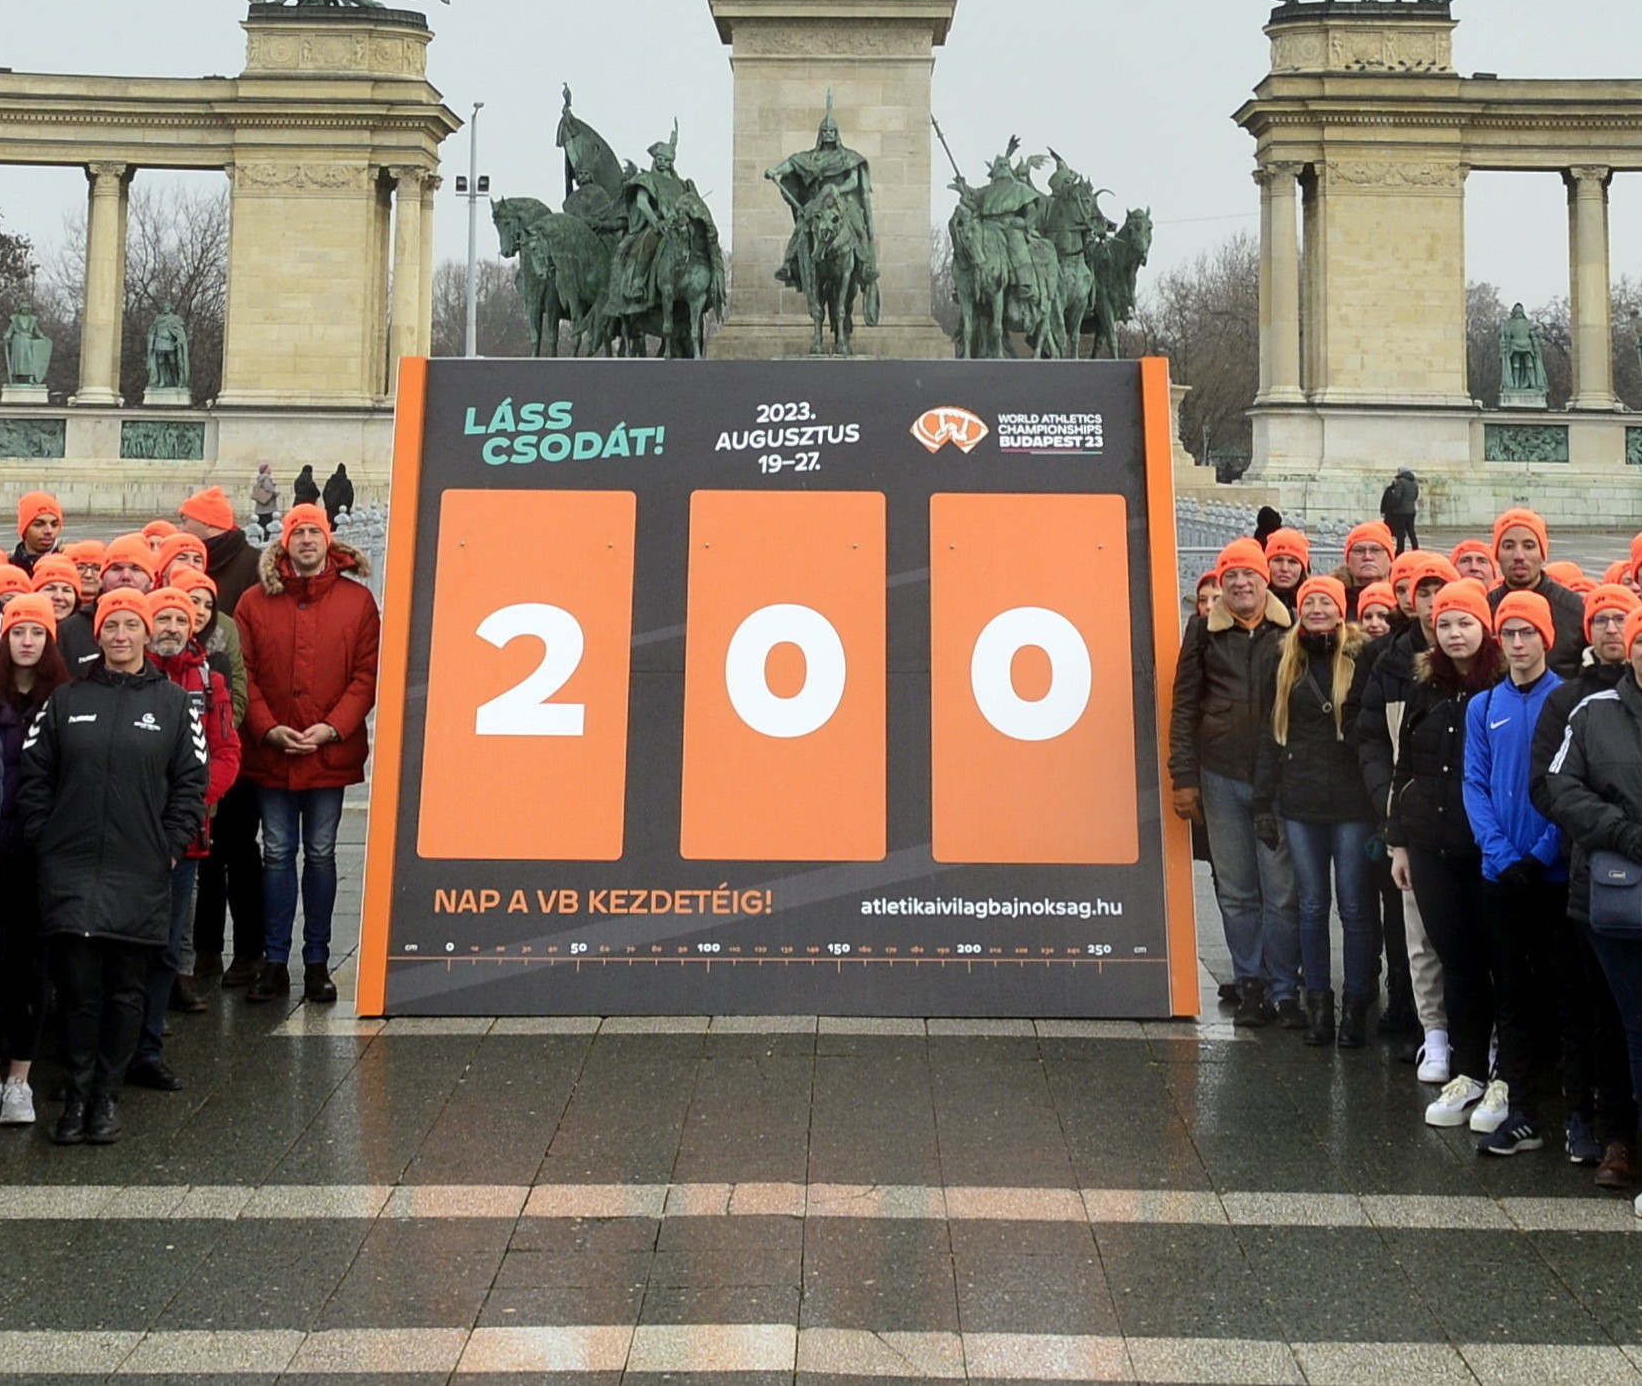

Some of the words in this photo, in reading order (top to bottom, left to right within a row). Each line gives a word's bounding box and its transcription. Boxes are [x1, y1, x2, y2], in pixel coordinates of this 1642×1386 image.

[464, 397, 574, 435] LÁSS
[756, 402, 817, 424] 2023.
[998, 413, 1039, 424] WORLD
[1041, 414, 1103, 424] ATHLETICS
[714, 423, 861, 452] AUGUSZTUS
[998, 424, 1103, 436] CHAMPIONSHIPS
[482, 421, 666, 466] CSODÁT!
[999, 436, 1084, 448] BUDAPEST
[1085, 436, 1104, 448] 23
[474, 602, 587, 737] 2
[725, 603, 847, 738] 0
[970, 606, 1093, 741] 0
[434, 889, 501, 914] NAP
[507, 889, 529, 914] A
[537, 889, 580, 914] VB
[588, 881, 773, 915] KEZDETÉIG!
[860, 896, 1123, 919] atletikaivilagbajnoksag.hu
[445, 942, 455, 952] 0
[570, 942, 588, 954] 50
[697, 942, 721, 953] 100
[827, 943, 851, 956] 150
[956, 943, 982, 955] 200
[1087, 943, 1112, 956] 250
[1133, 945, 1147, 954] cm
